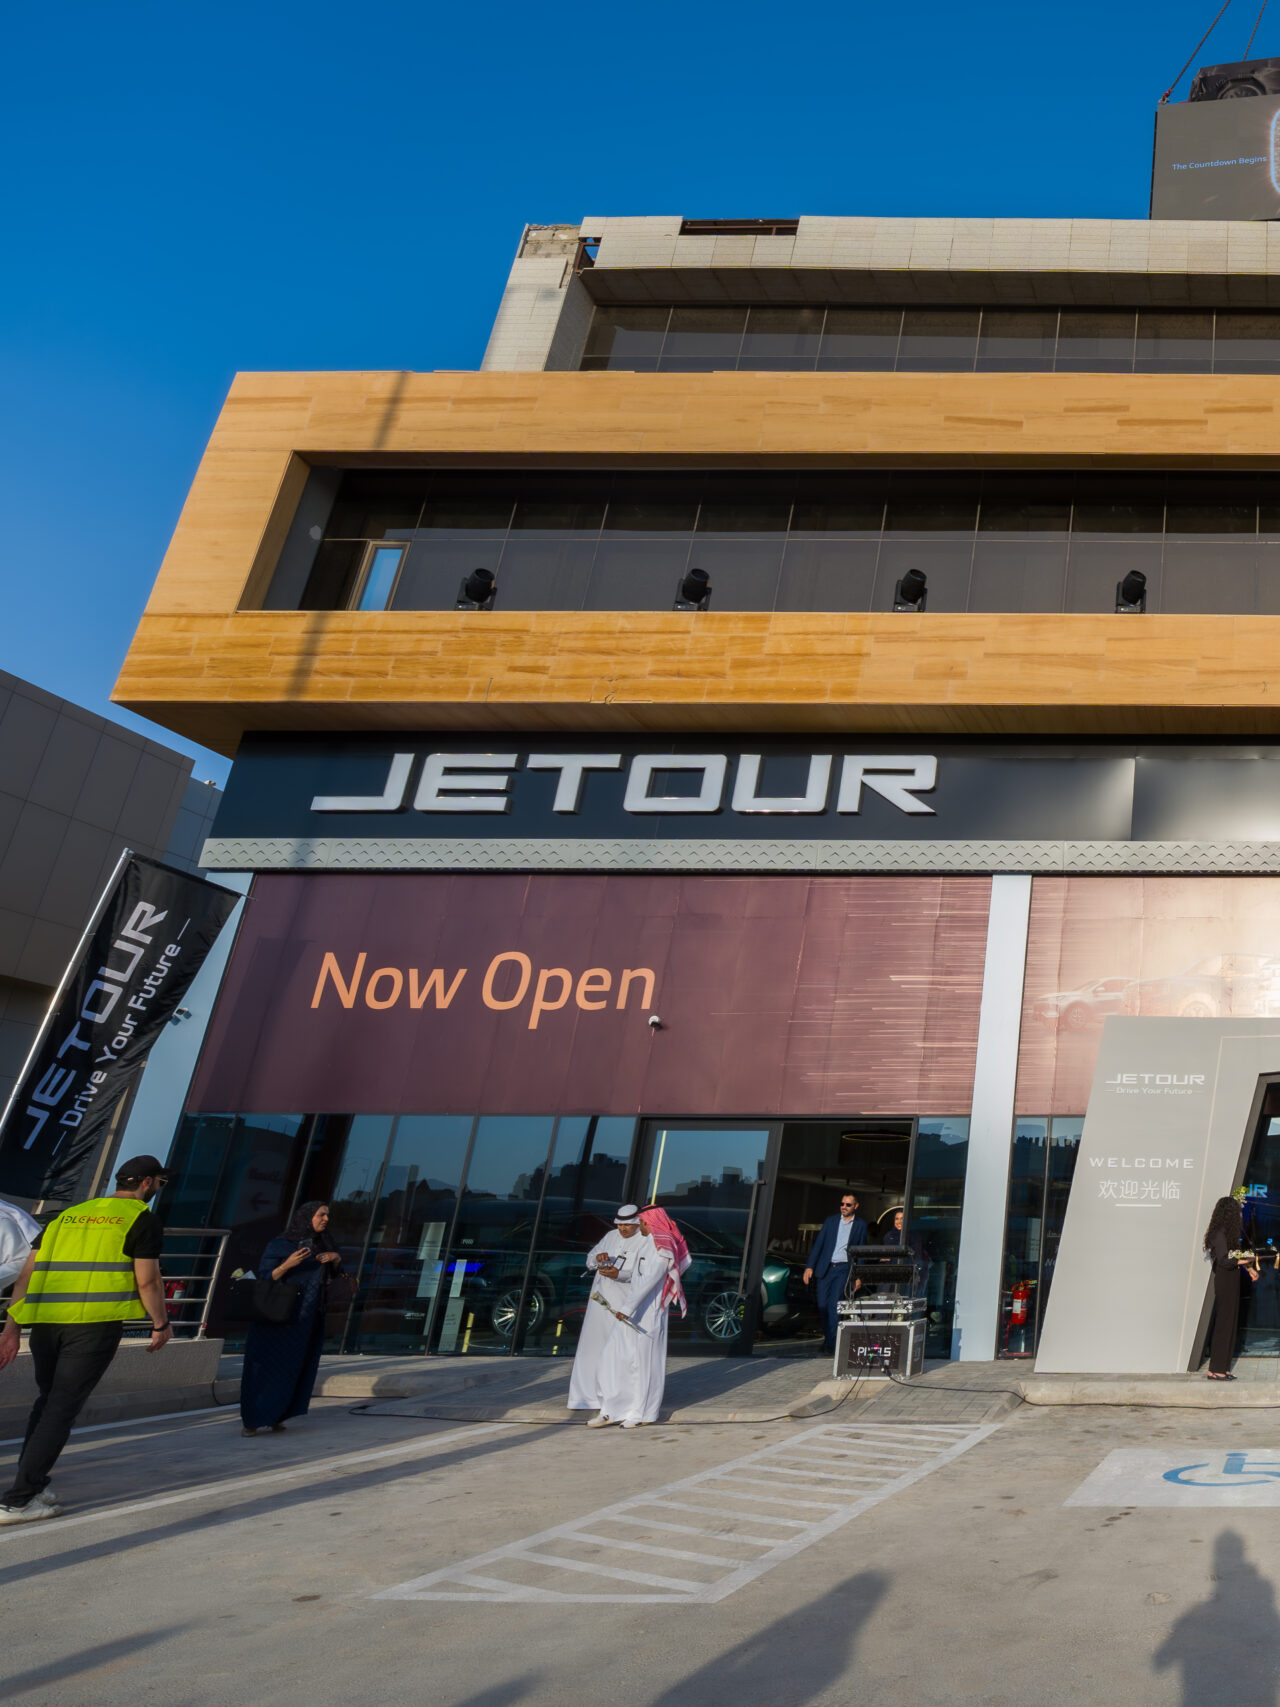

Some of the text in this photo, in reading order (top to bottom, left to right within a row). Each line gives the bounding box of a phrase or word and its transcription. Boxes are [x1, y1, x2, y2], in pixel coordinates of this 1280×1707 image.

[1189, 159, 1237, 169] Countdown
[1238, 156, 1267, 165] Begins
[310, 752, 938, 814] JETOUR
[311, 951, 656, 1030] Now Open
[23, 901, 168, 1150] JETOUR
[59, 943, 181, 1128] Drive Your Future
[1105, 1074, 1205, 1085] JETOUR
[1116, 1087, 1139, 1095] Drive
[1142, 1087, 1161, 1095] Your
[1089, 1157, 1195, 1169] WELCOME
[1098, 1180, 1181, 1200] 欢迎光临
